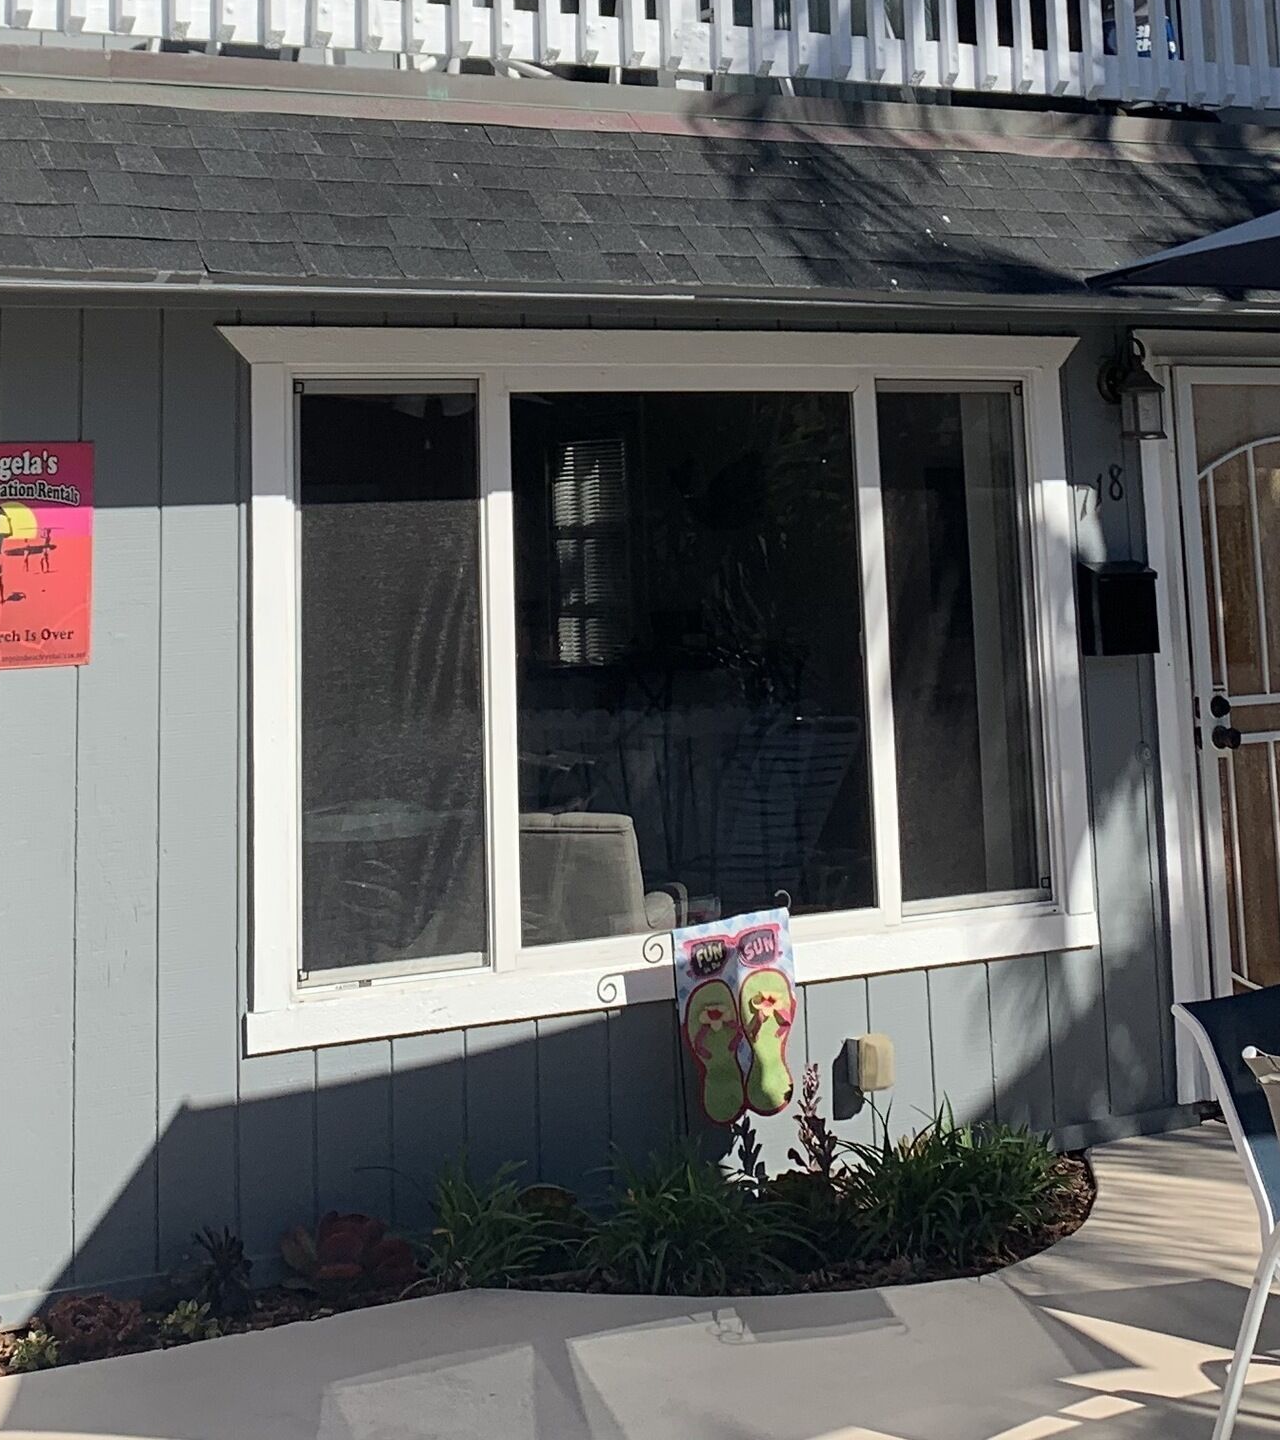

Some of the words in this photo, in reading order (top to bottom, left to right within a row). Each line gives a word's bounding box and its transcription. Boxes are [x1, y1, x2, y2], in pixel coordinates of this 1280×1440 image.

[38, 480, 80, 506] Rentals
[1076, 464, 1123, 521] 718
[25, 629, 37, 642] Is
[41, 628, 74, 641] Over
[696, 943, 723, 969] FUN
[743, 937, 775, 962] SUN
